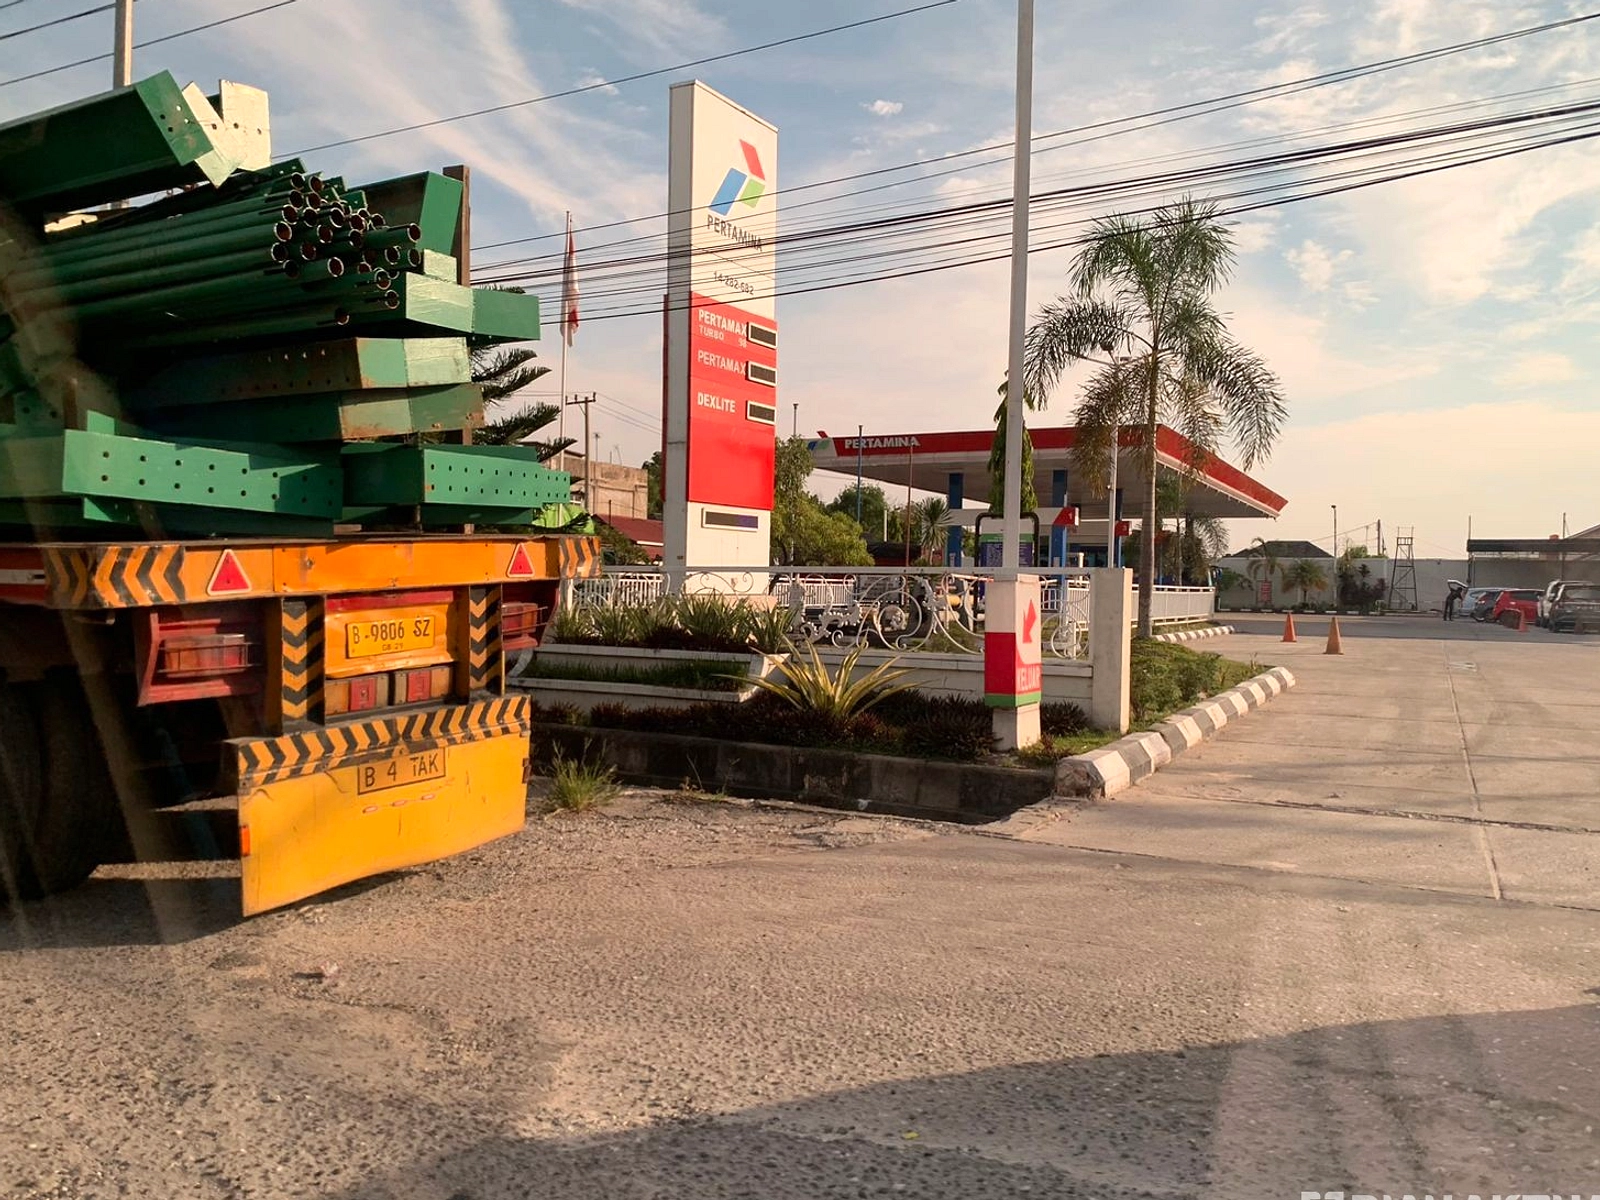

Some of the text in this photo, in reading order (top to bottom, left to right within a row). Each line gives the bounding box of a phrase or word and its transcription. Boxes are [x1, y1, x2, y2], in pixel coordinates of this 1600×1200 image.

[707, 214, 763, 252] PERTAMINA
[698, 309, 747, 337] PERTAMAX
[699, 325, 724, 340] TURBO
[698, 350, 746, 375] PERTAMAX
[697, 392, 736, 413] DEXLITE
[844, 436, 920, 449] PERTAMINA
[412, 619, 431, 638] SZ
[364, 752, 439, 788] B 4 TAK
